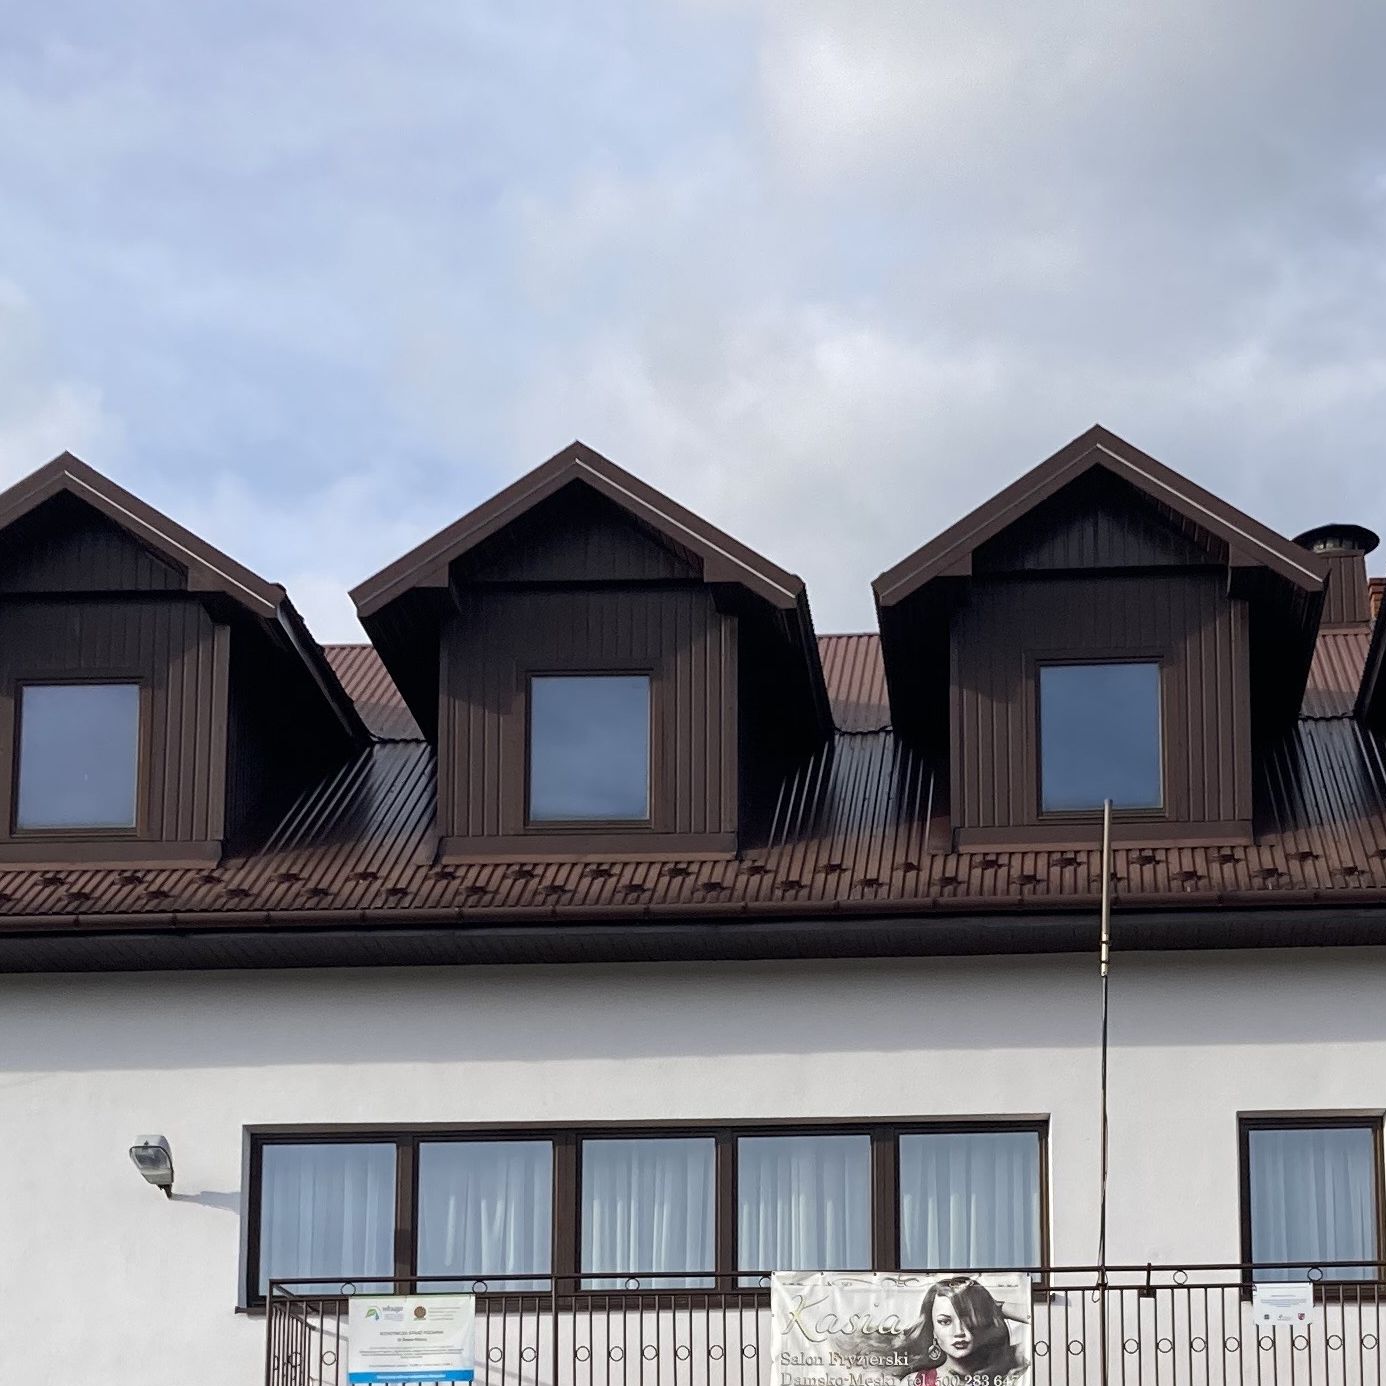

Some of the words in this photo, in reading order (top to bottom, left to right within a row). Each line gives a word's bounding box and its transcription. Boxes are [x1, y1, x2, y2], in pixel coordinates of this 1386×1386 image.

[781, 1294, 903, 1342] Kasia
[780, 1352, 825, 1367] Salon
[828, 1351, 909, 1370] Fryzjerski
